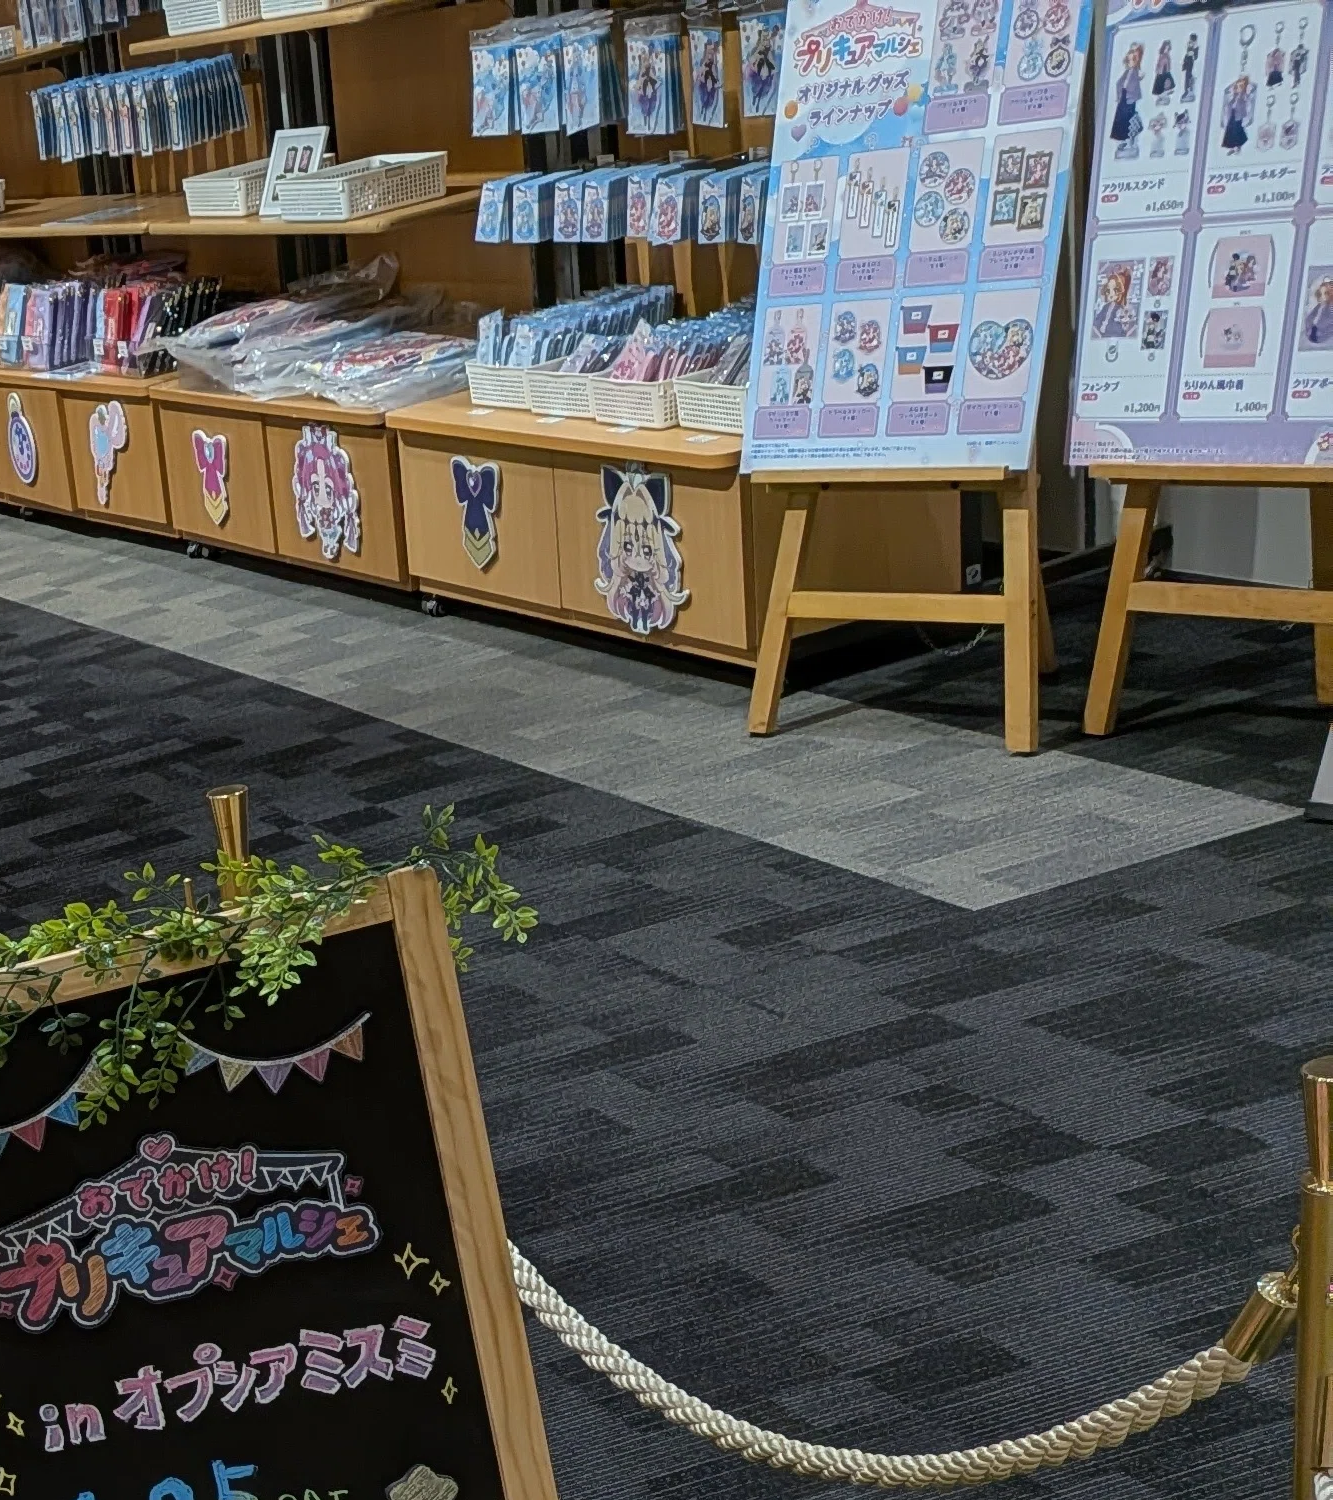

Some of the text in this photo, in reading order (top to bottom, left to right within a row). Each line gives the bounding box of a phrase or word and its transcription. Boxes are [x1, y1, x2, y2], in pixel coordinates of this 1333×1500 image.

[796, 34, 921, 74] プリキュアマルシェ
[799, 70, 910, 102] オリジナルグッズ
[809, 98, 893, 127] ラインナップ
[1101, 178, 1166, 194] アクリルスタンド
[76, 1148, 258, 1219] おでかけ!
[38, 1314, 437, 1452] in オプシアミスミ
